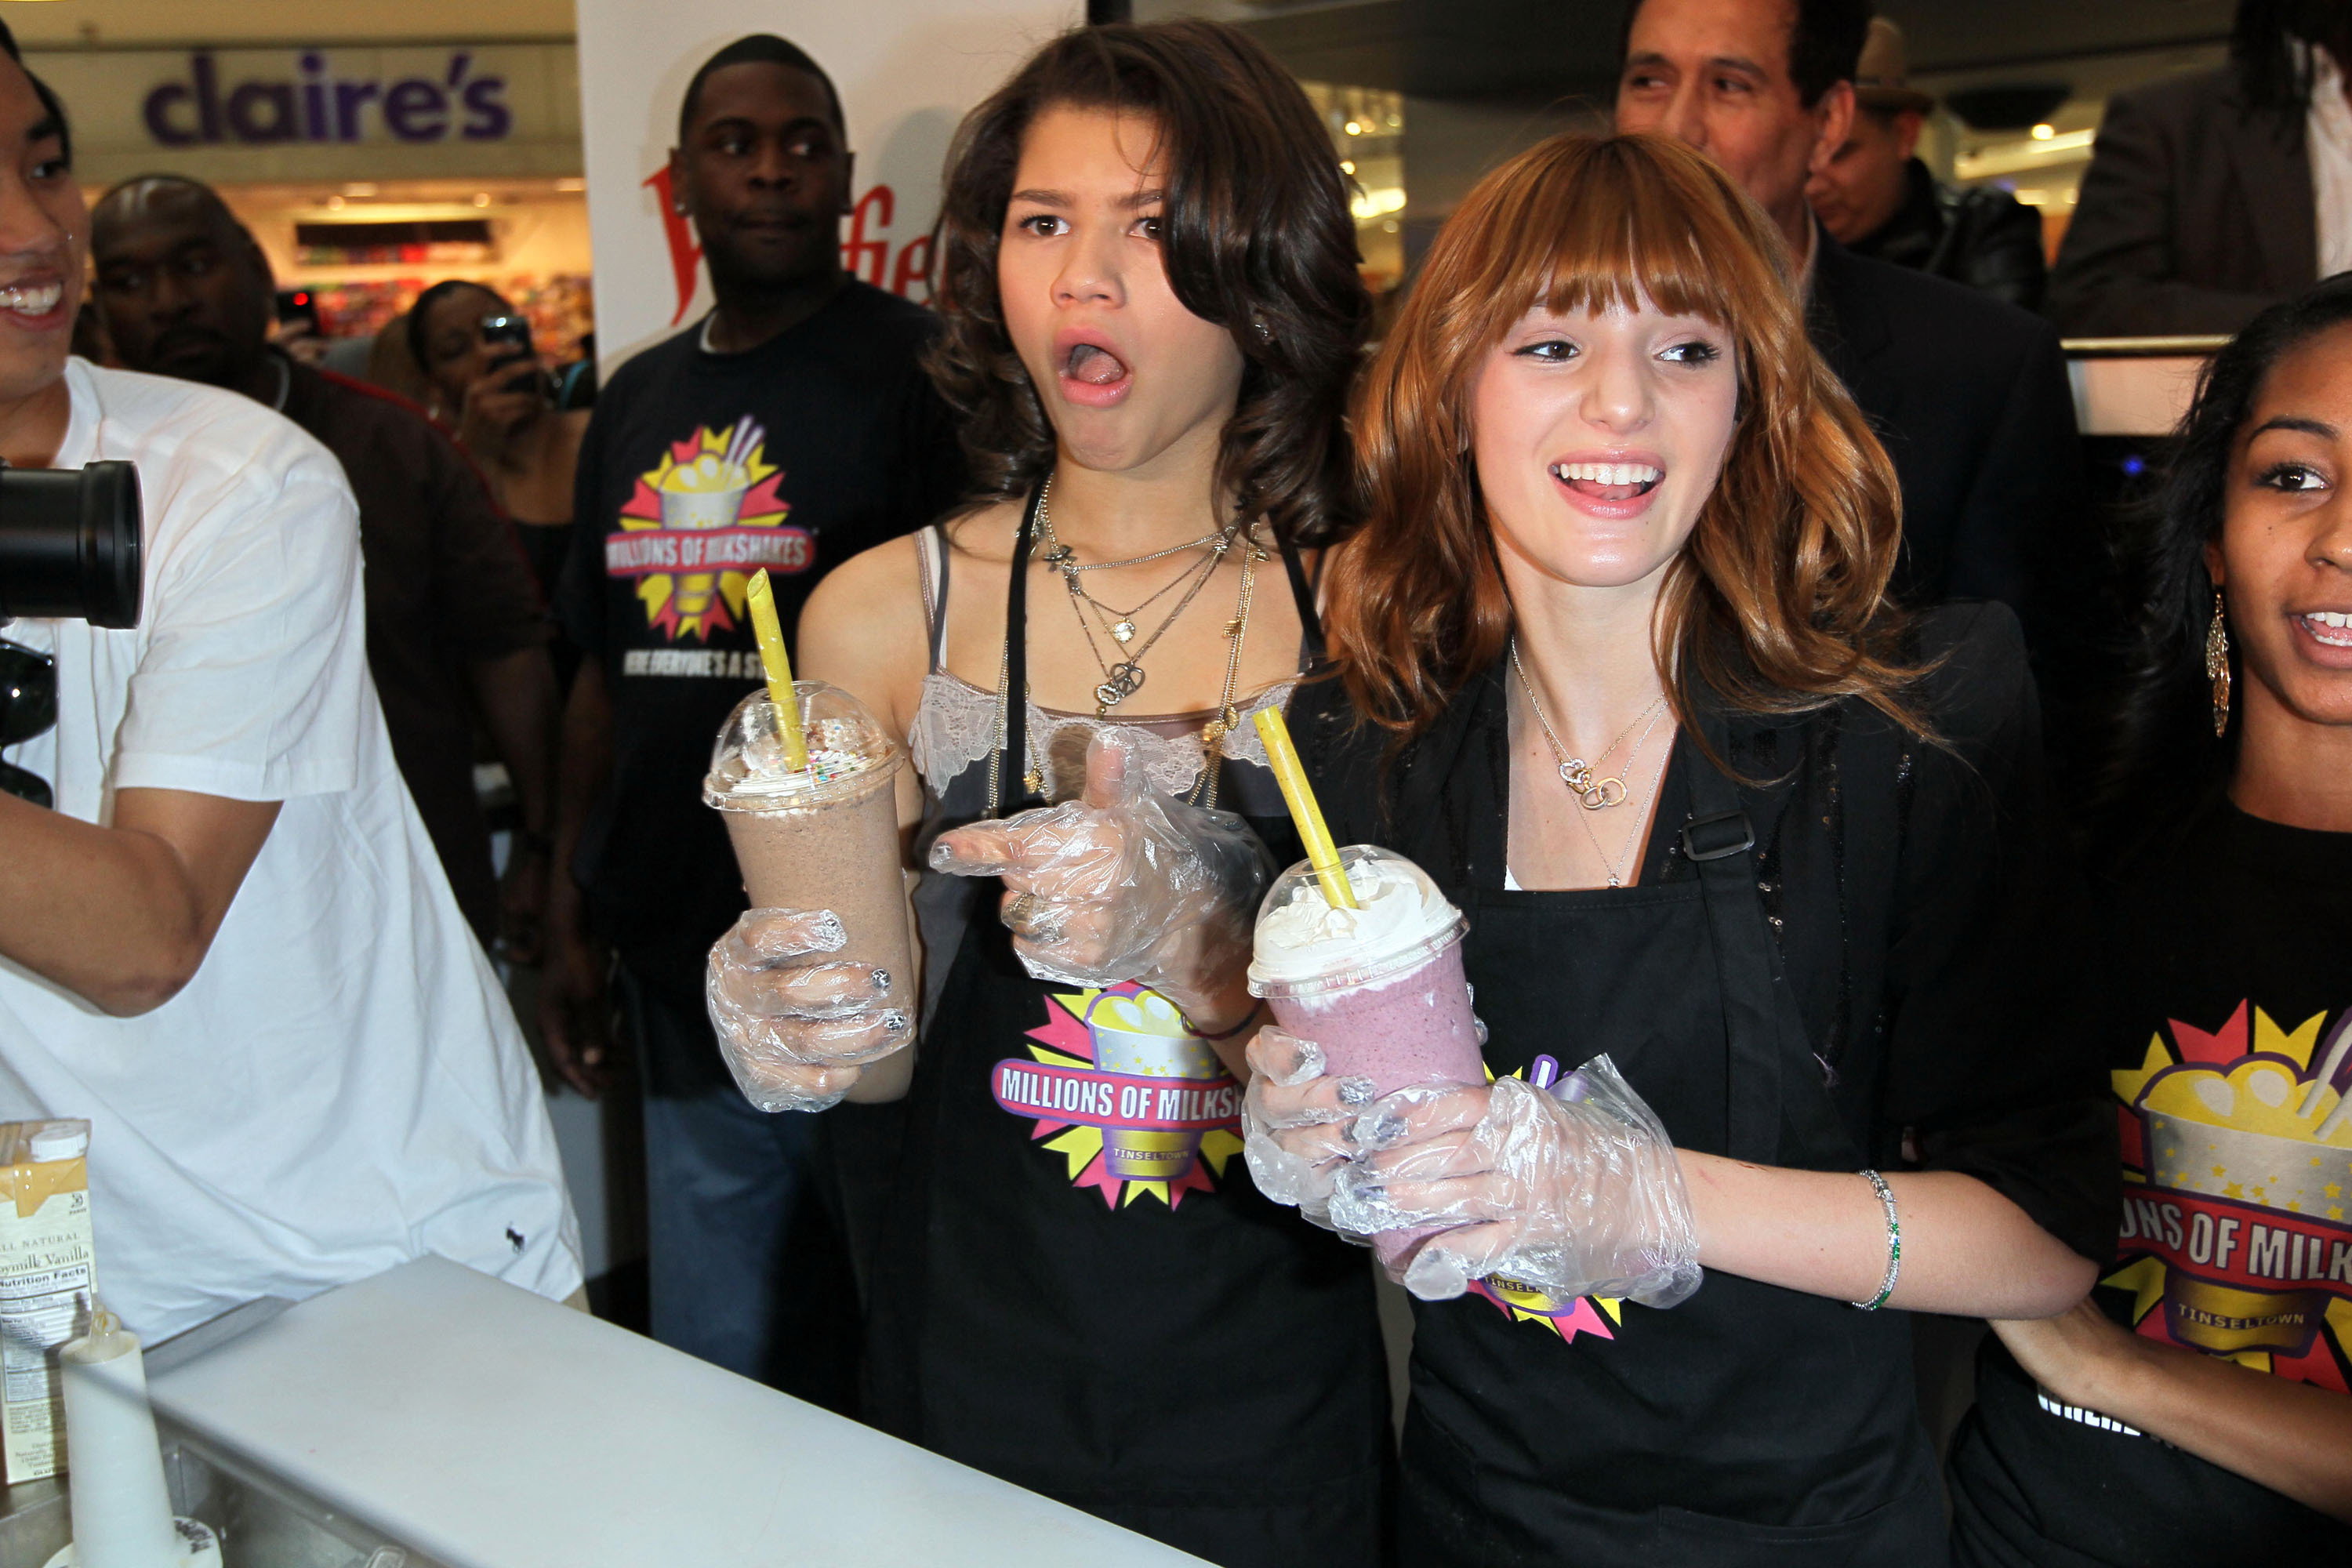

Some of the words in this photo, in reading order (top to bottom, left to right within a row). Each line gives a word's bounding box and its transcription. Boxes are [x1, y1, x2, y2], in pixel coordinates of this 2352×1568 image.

[143, 50, 511, 147] claire's
[607, 536, 677, 569] MILLIONS
[681, 536, 704, 567] OF
[1001, 1068, 1115, 1117] MILLIONS
[1120, 1085, 1153, 1120] OF
[1113, 1148, 1190, 1161] TINSELTOWN
[0, 1243, 16, 1253] LL
[22, 1232, 80, 1249] NATURAL
[2189, 1213, 2241, 1270] OF
[45, 1245, 89, 1265] Vanilla
[53, 1268, 86, 1279] Facts
[1485, 1276, 1541, 1293] TINSEL
[2179, 1303, 2305, 1329] TINSELTOWN
